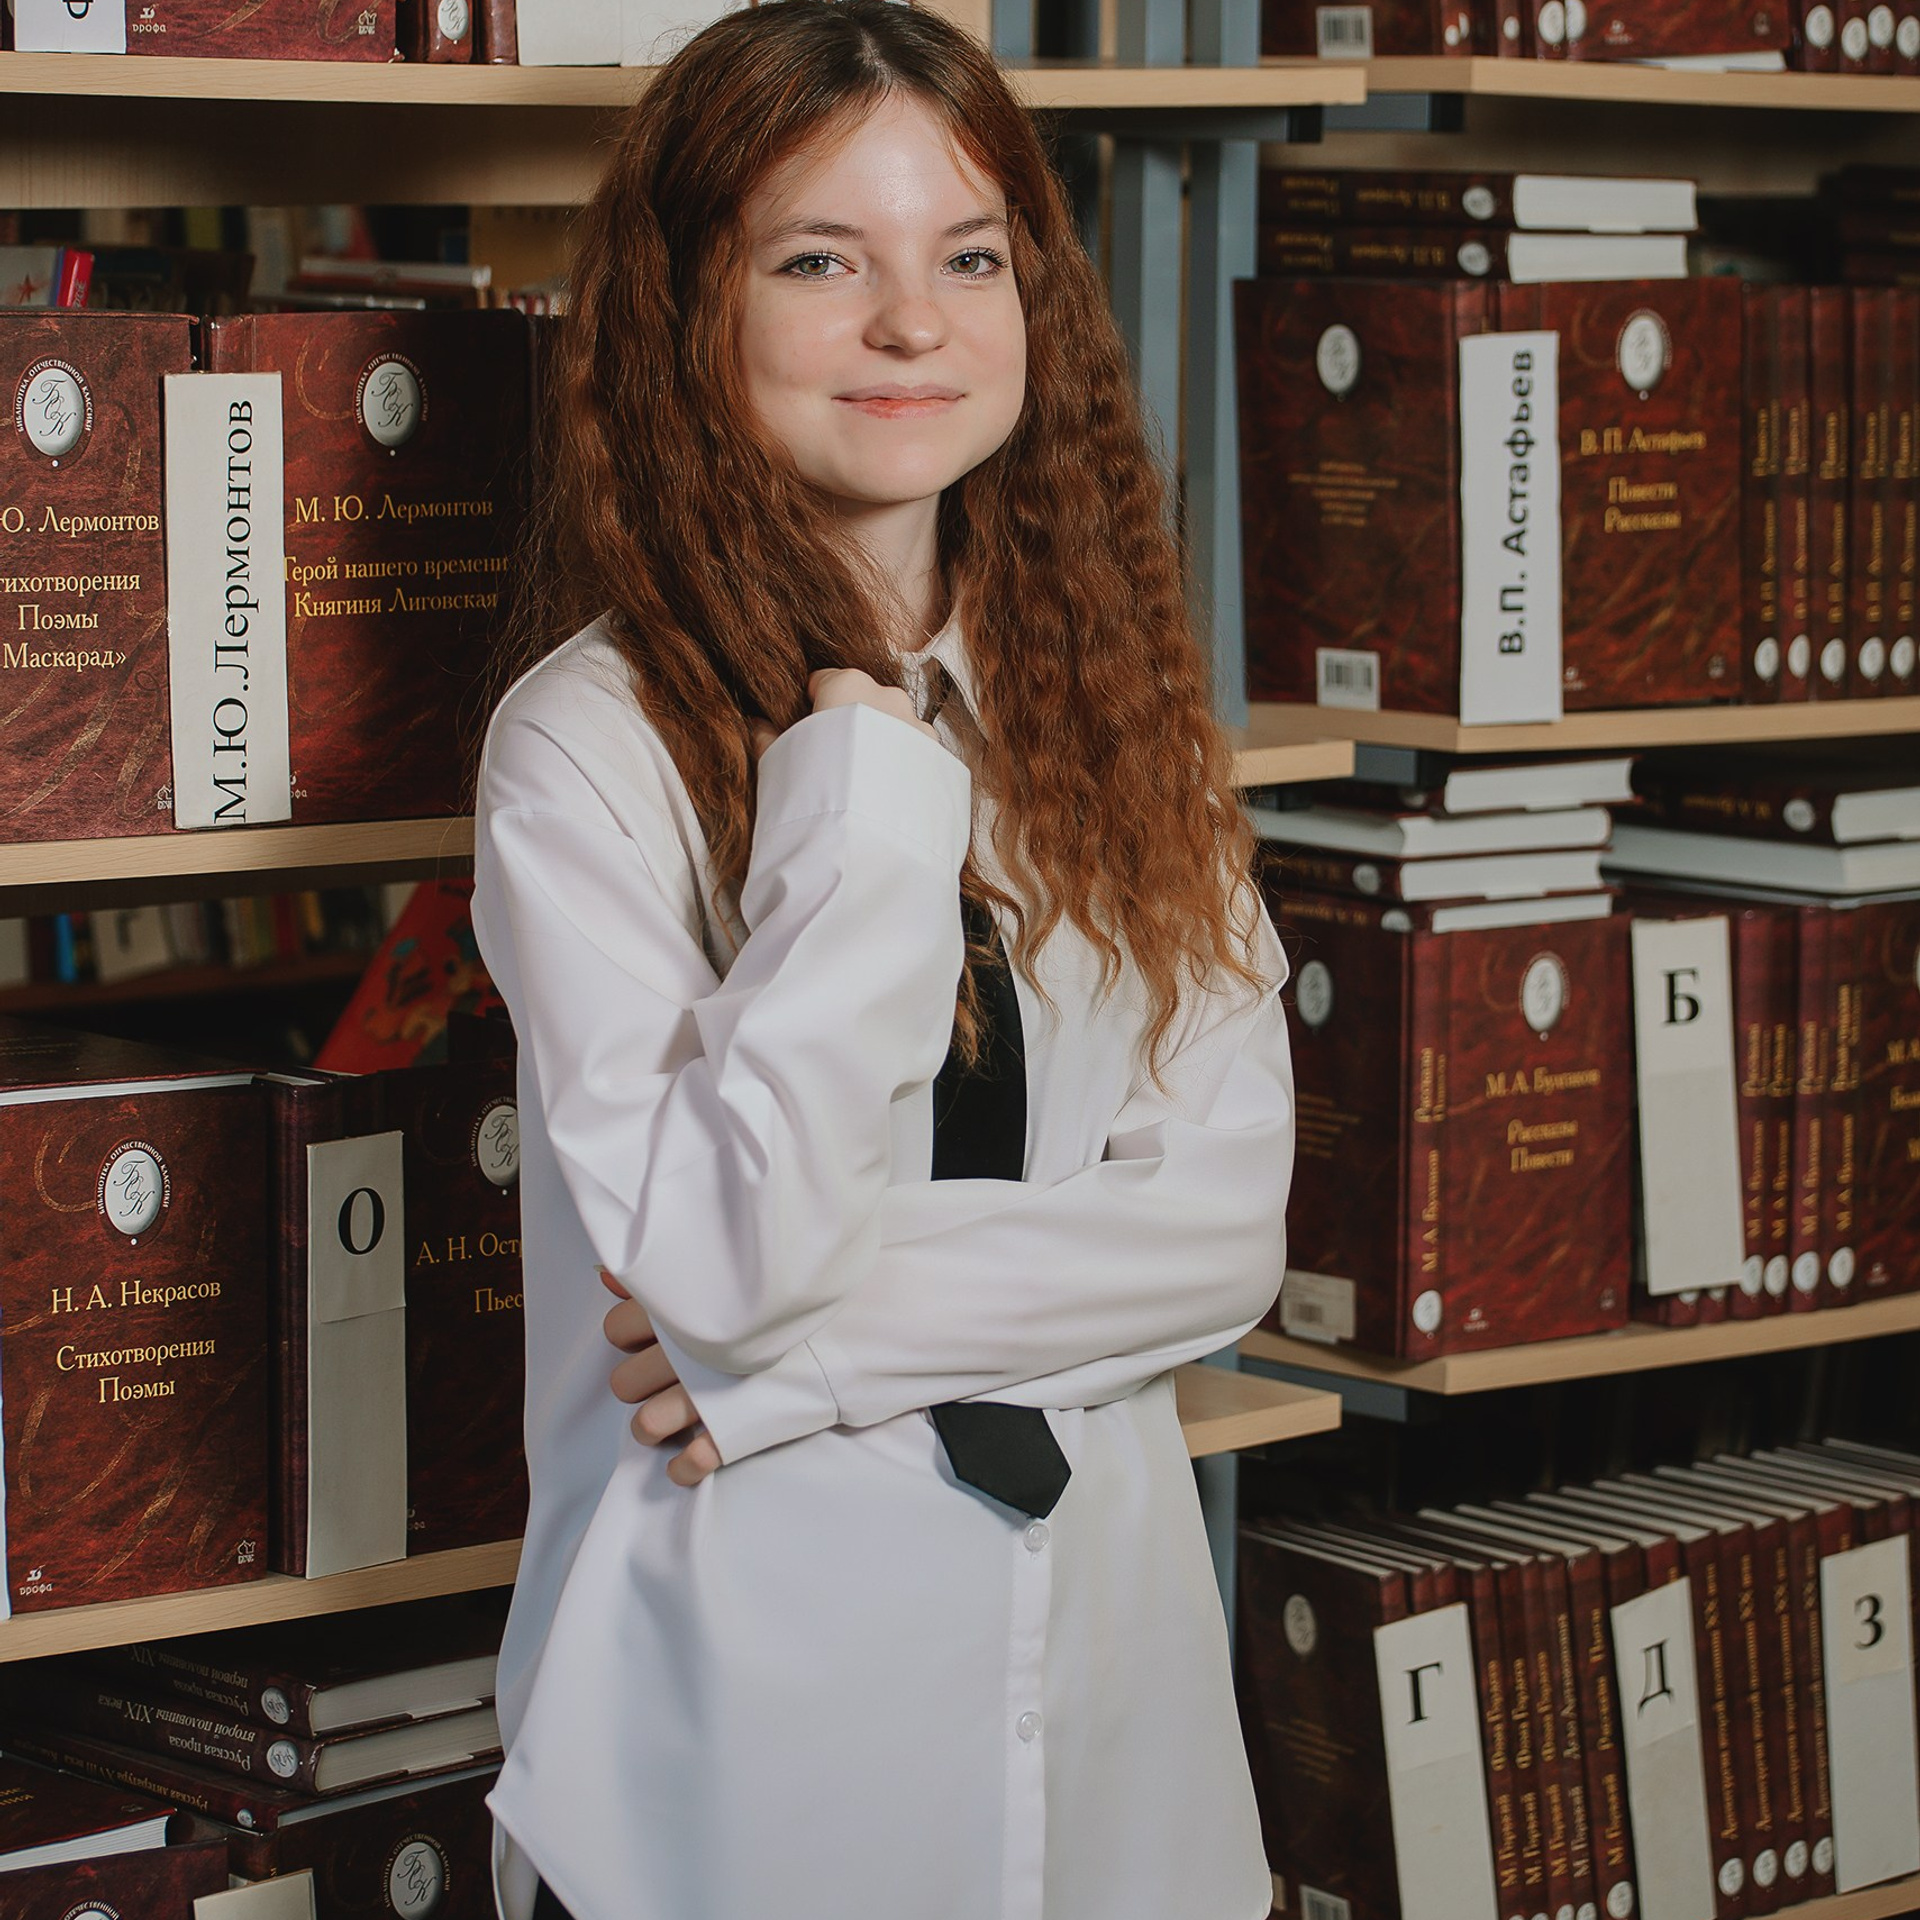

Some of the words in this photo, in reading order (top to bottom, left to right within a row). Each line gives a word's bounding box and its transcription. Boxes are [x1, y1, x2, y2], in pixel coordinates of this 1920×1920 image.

[1501, 348, 1536, 557] Астафьев
[38, 506, 160, 538] Лермонтов
[295, 496, 326, 523] М.
[333, 495, 370, 521] Ю.
[377, 494, 494, 524] Лермонтов
[284, 555, 339, 587] Герой
[344, 559, 419, 579] нашего
[424, 556, 509, 580] времени
[18, 604, 99, 631] Поэмы
[293, 591, 382, 618] Княгиня
[388, 587, 498, 612] Лиговская
[2, 642, 127, 673] Маскарад»
[1660, 966, 1700, 1024] Б
[338, 1187, 386, 1256] О
[416, 1241, 440, 1266] А.
[447, 1236, 472, 1262] Н.
[51, 1287, 80, 1314] Н.
[85, 1284, 113, 1311] А.
[120, 1280, 221, 1308] Некрасов
[475, 1287, 523, 1313] Пьес
[56, 1339, 216, 1372] Стихотворения
[98, 1376, 176, 1403] Поэмы
[1637, 1637, 1675, 1718] Д
[97, 1693, 123, 1710] века
[204, 1688, 250, 1717] Русская
[1404, 1661, 1443, 1725] Г
[123, 1700, 155, 1724] XIX
[154, 1708, 214, 1732] половины
[167, 1734, 202, 1752] проза
[213, 1723, 256, 1743] второй
[203, 1744, 251, 1772] Русская
[169, 1788, 209, 1812] Русская
